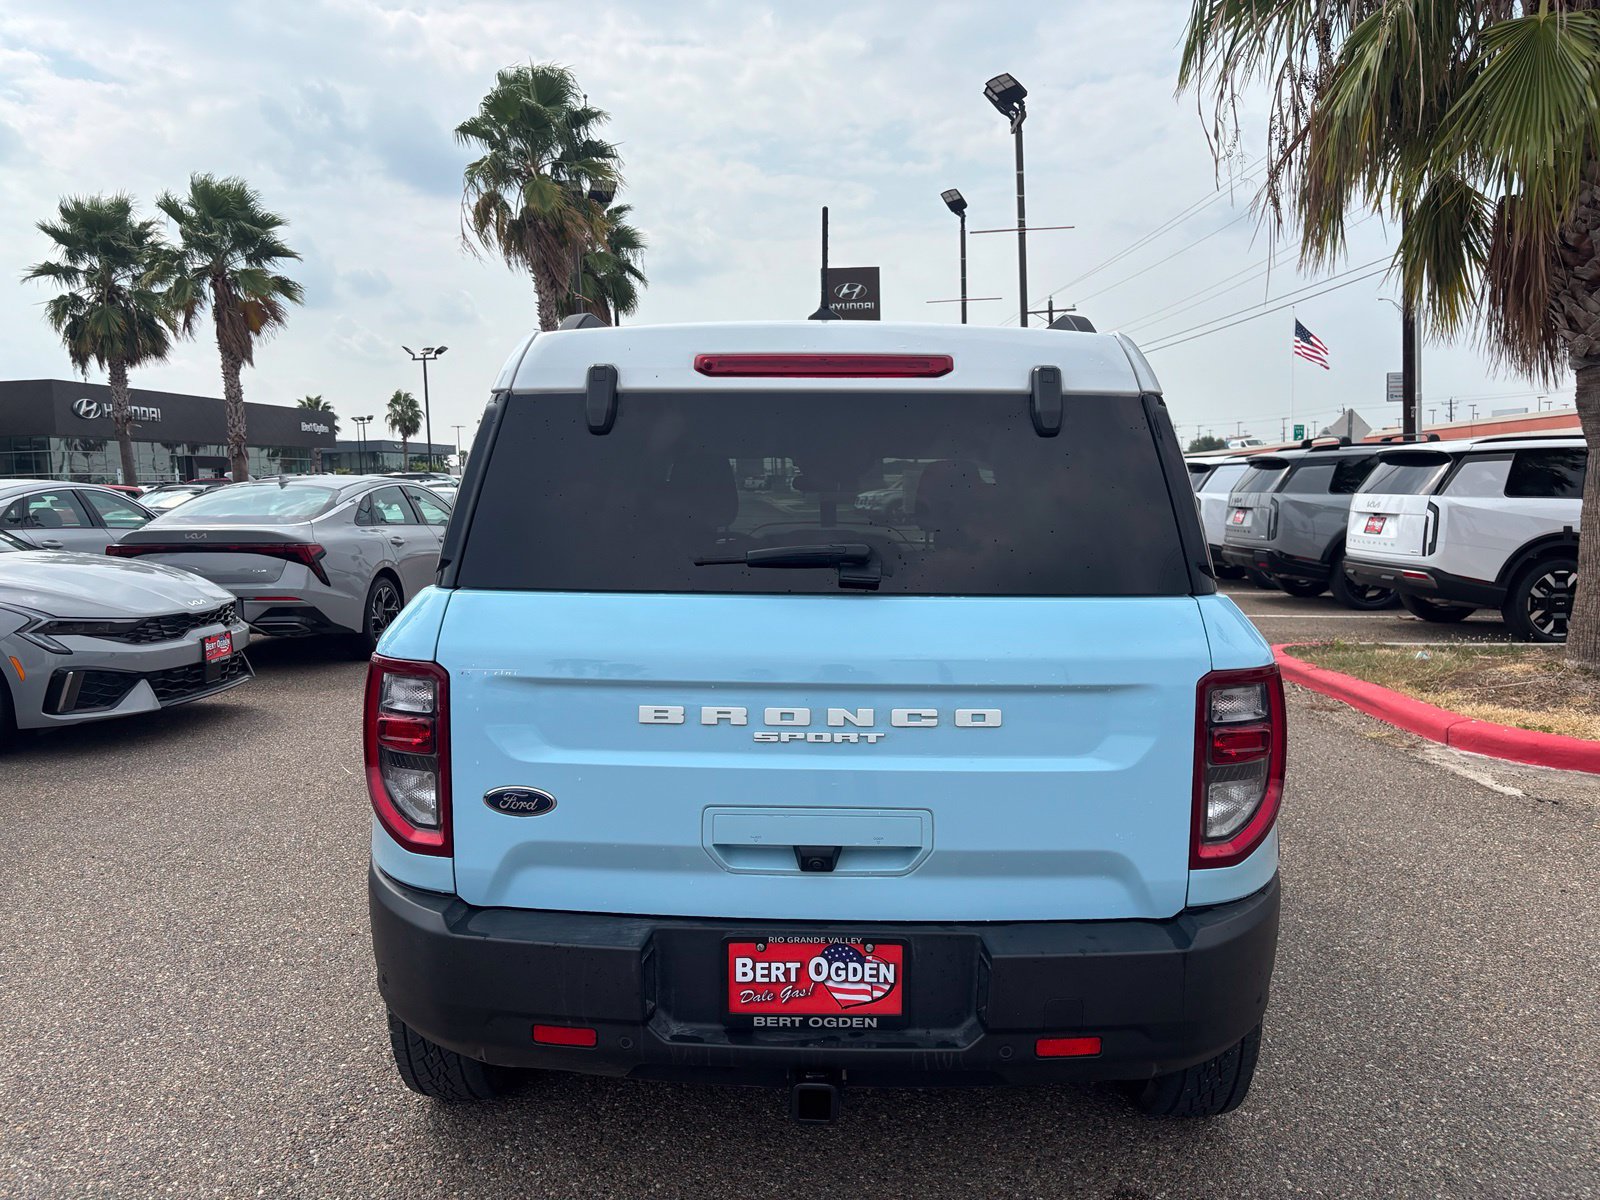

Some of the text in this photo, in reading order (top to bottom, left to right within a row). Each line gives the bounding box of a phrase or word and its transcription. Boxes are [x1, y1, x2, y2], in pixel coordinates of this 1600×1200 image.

[829, 302, 875, 310] HYUNDAI
[103, 403, 162, 422] HNDAI
[638, 705, 1002, 727] BRONCO
[753, 731, 885, 744] SPORT
[499, 792, 539, 811] Ford
[768, 936, 862, 945] RIO GRANDE VALLEY
[735, 956, 895, 984] BERT OGDEN
[739, 982, 815, 1004] Dale Gas!
[753, 1016, 878, 1028] BERT OGDEN
